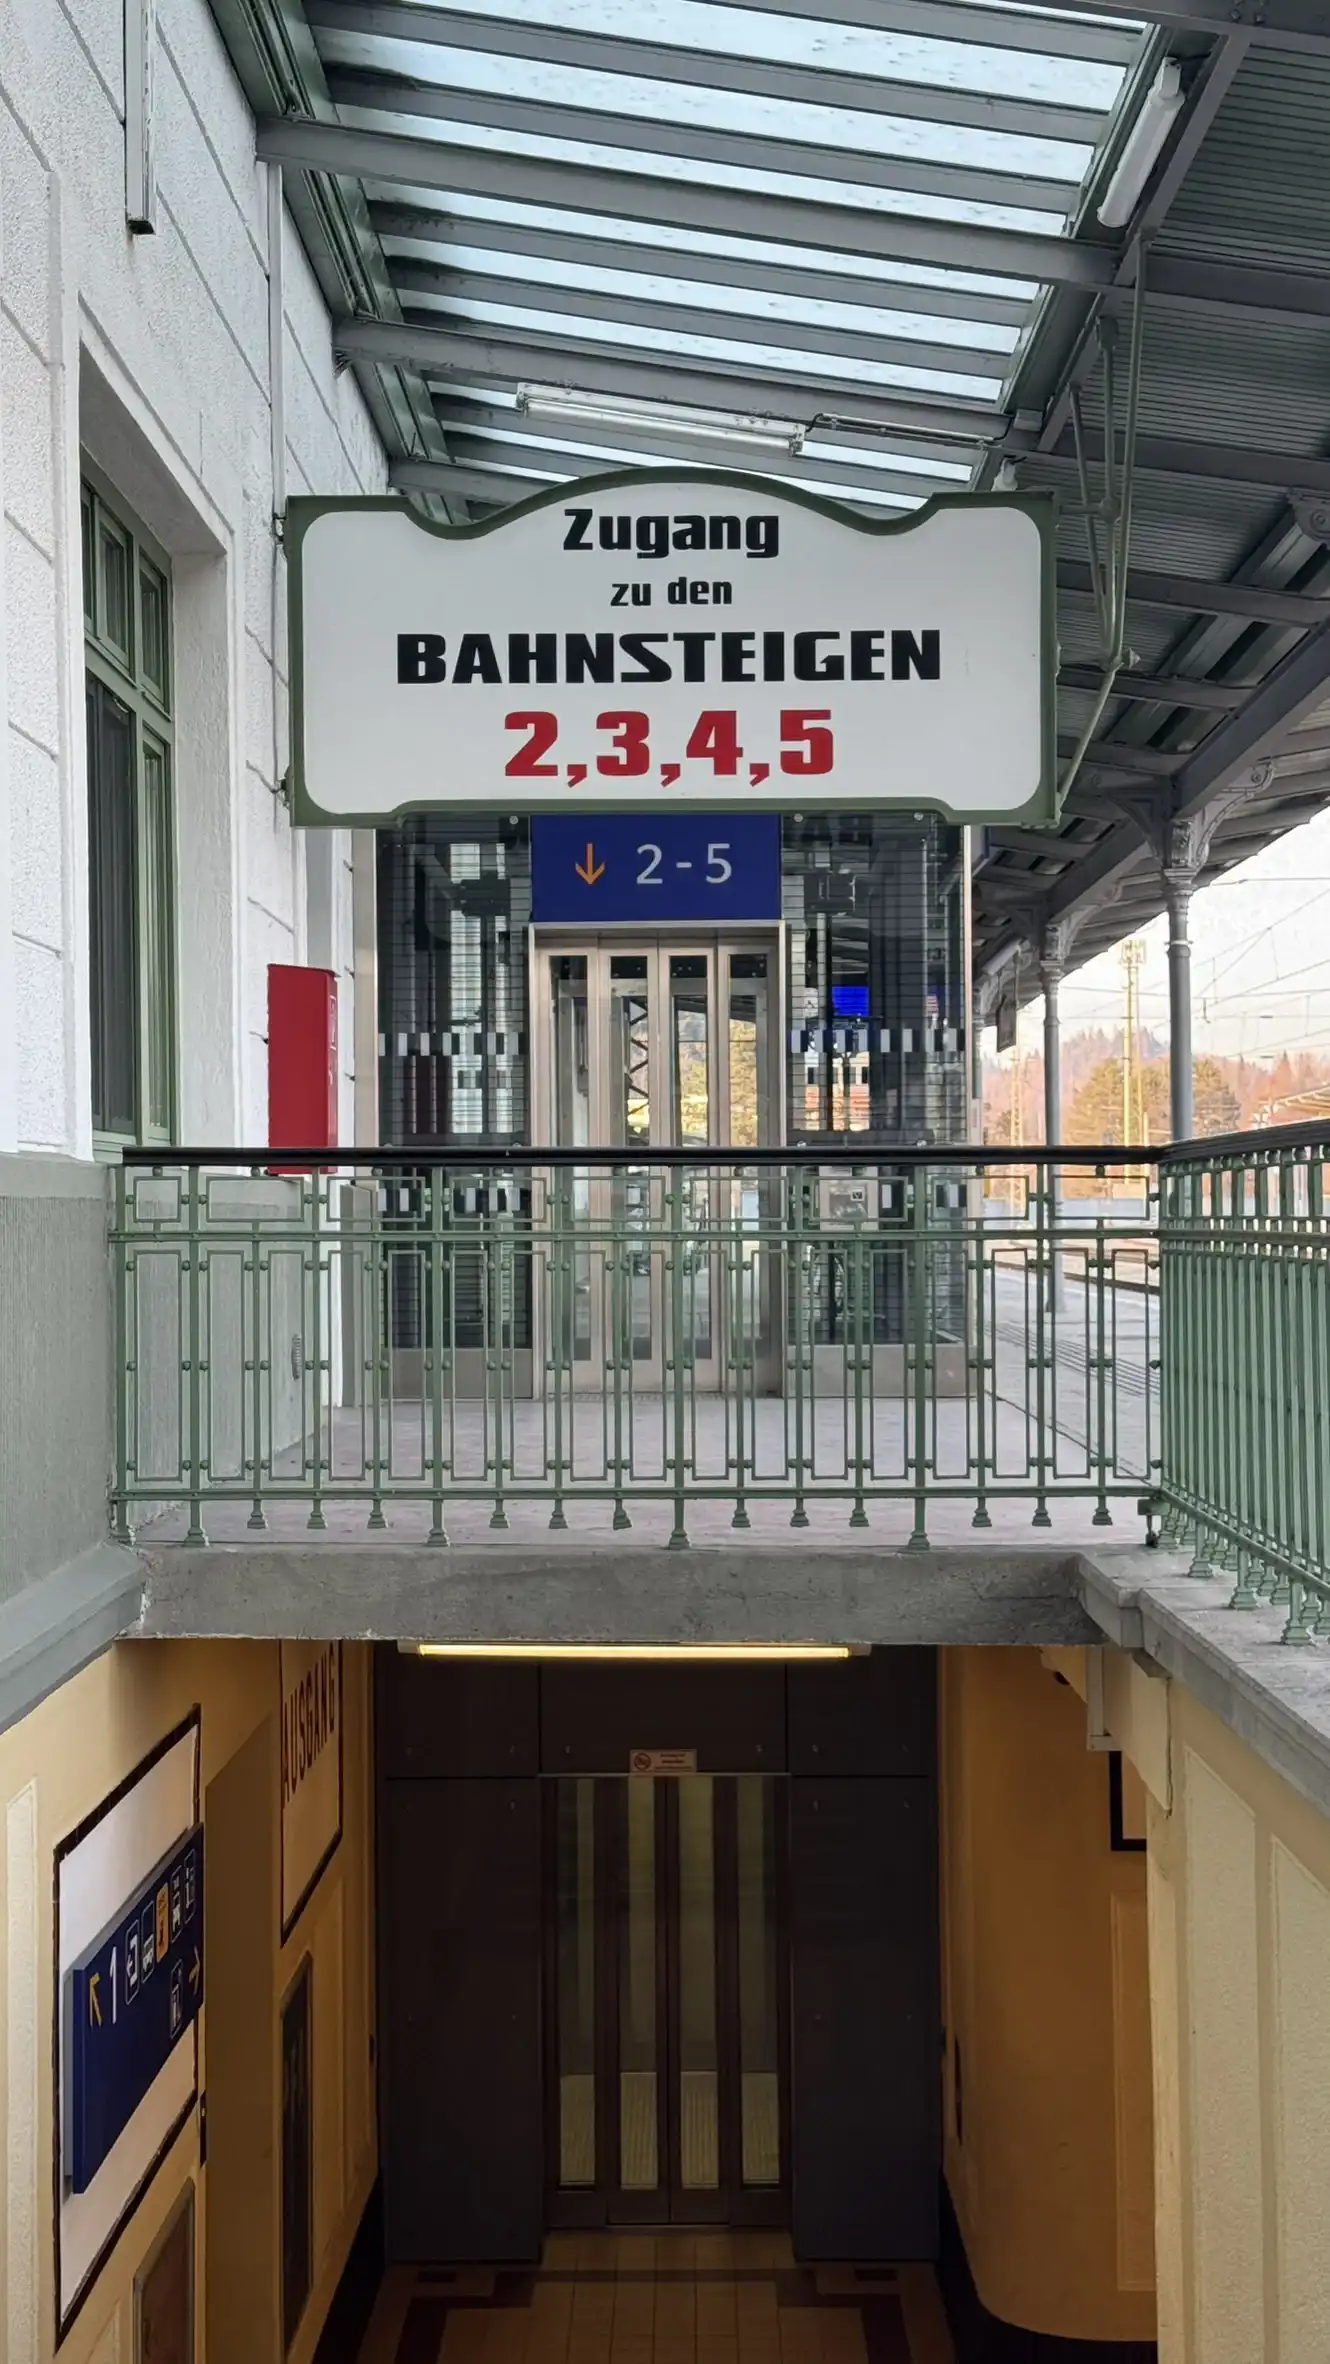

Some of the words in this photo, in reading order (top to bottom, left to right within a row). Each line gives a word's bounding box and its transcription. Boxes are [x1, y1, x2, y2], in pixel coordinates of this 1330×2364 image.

[564, 508, 780, 560] Zugang
[610, 583, 652, 607] zu
[667, 576, 733, 605] den
[397, 630, 941, 684] BAHNSTEIGEN
[506, 710, 834, 785] 2,3,4,5
[282, 1642, 336, 1807] AUSGANG
[109, 1946, 118, 2025] 1
